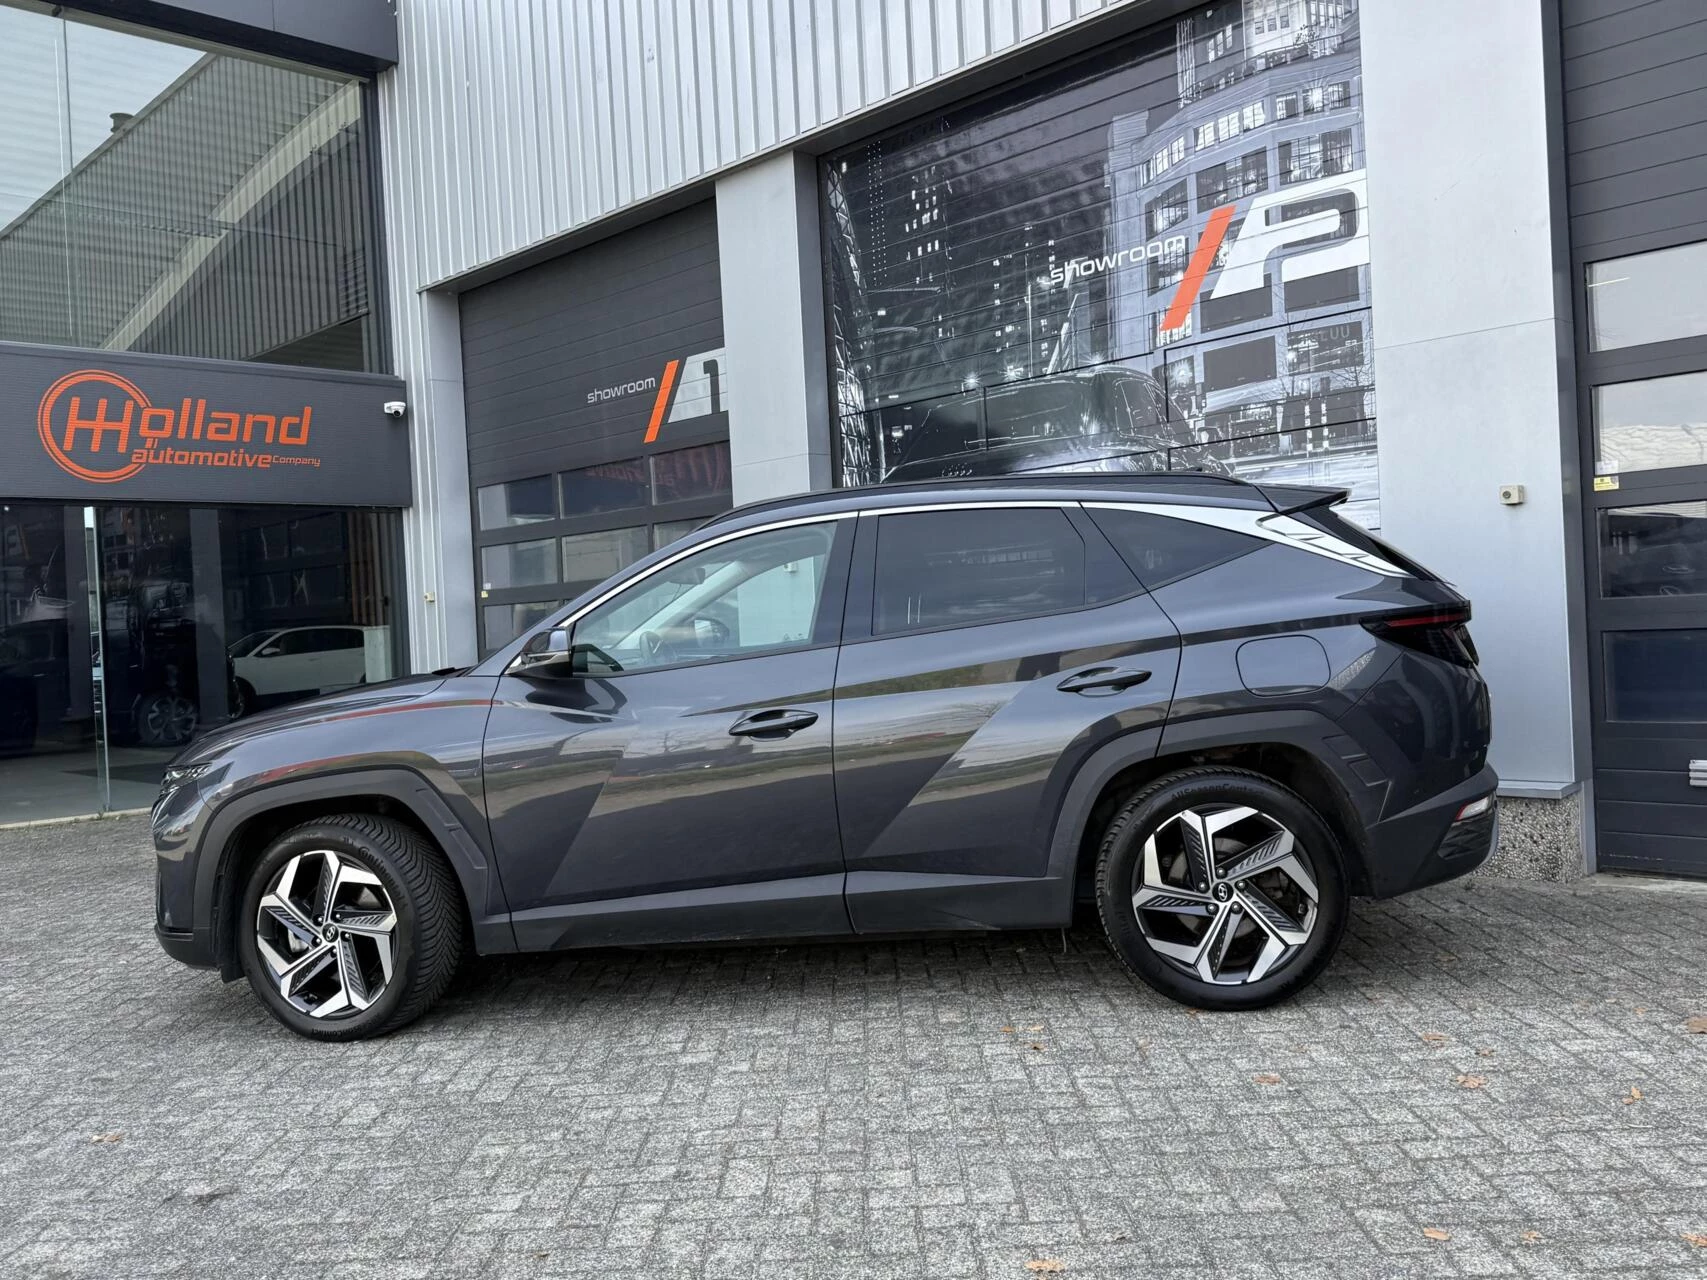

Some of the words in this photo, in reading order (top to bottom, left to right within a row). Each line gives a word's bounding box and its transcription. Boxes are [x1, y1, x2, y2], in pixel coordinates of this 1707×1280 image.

[1050, 234, 1186, 285] showroom
[586, 376, 656, 404] showroom
[131, 448, 272, 469] automotive
[272, 454, 321, 468] Company
